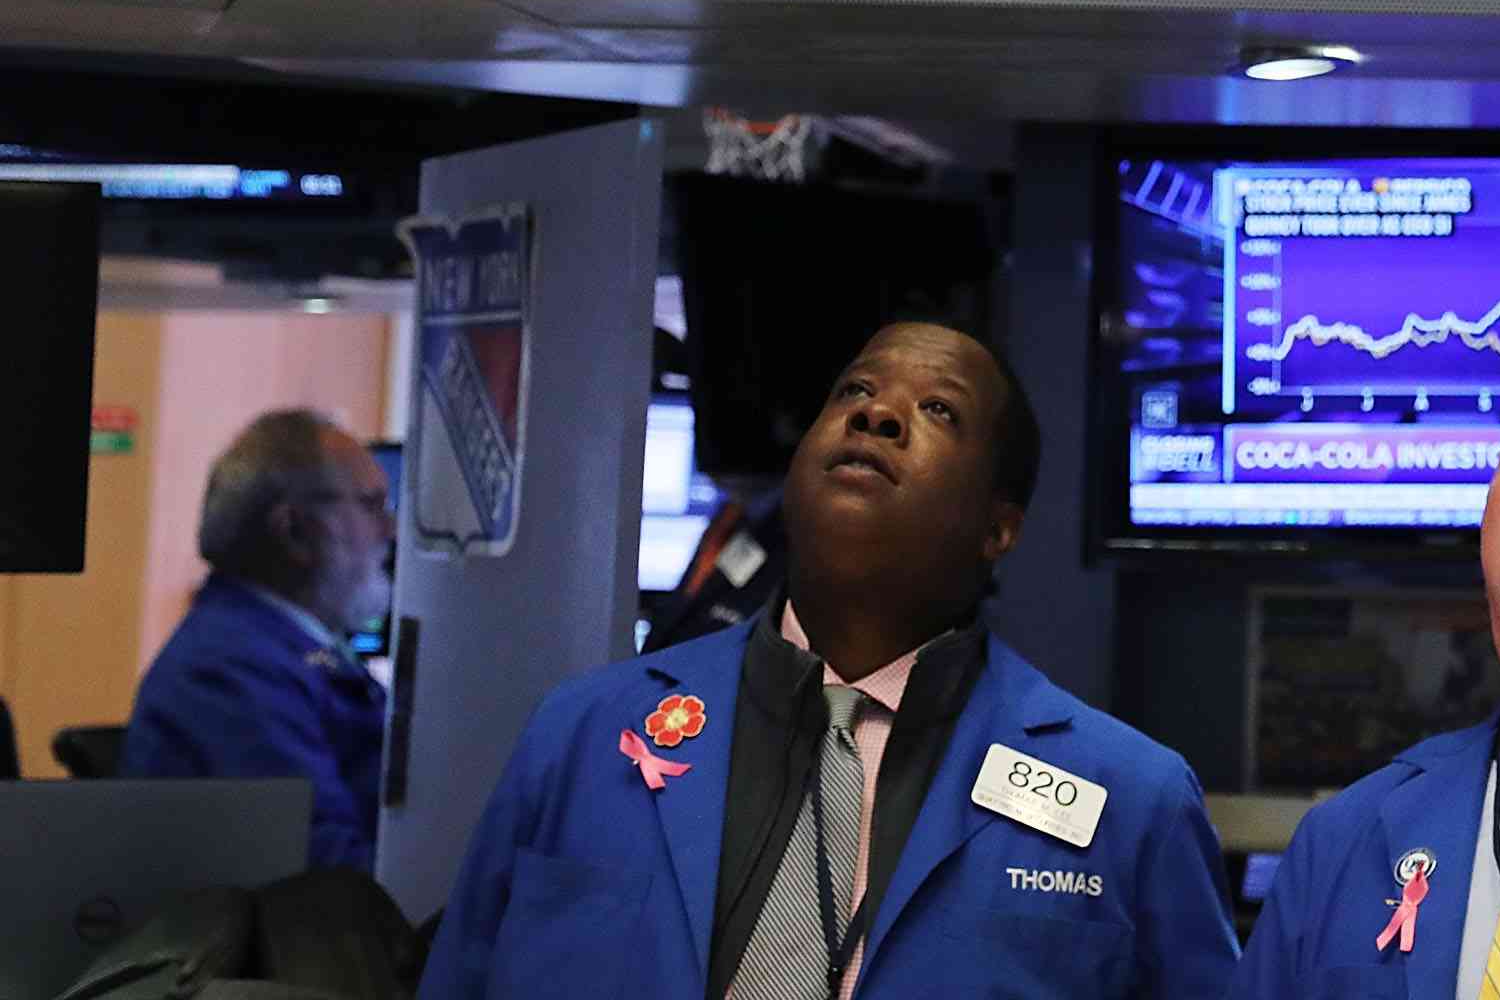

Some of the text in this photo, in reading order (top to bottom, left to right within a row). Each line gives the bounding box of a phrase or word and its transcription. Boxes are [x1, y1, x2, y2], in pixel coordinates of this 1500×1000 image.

[1236, 441, 1394, 469] COCA-COLA
[1008, 761, 1078, 807] 820
[1006, 867, 1104, 897] THOMAS
